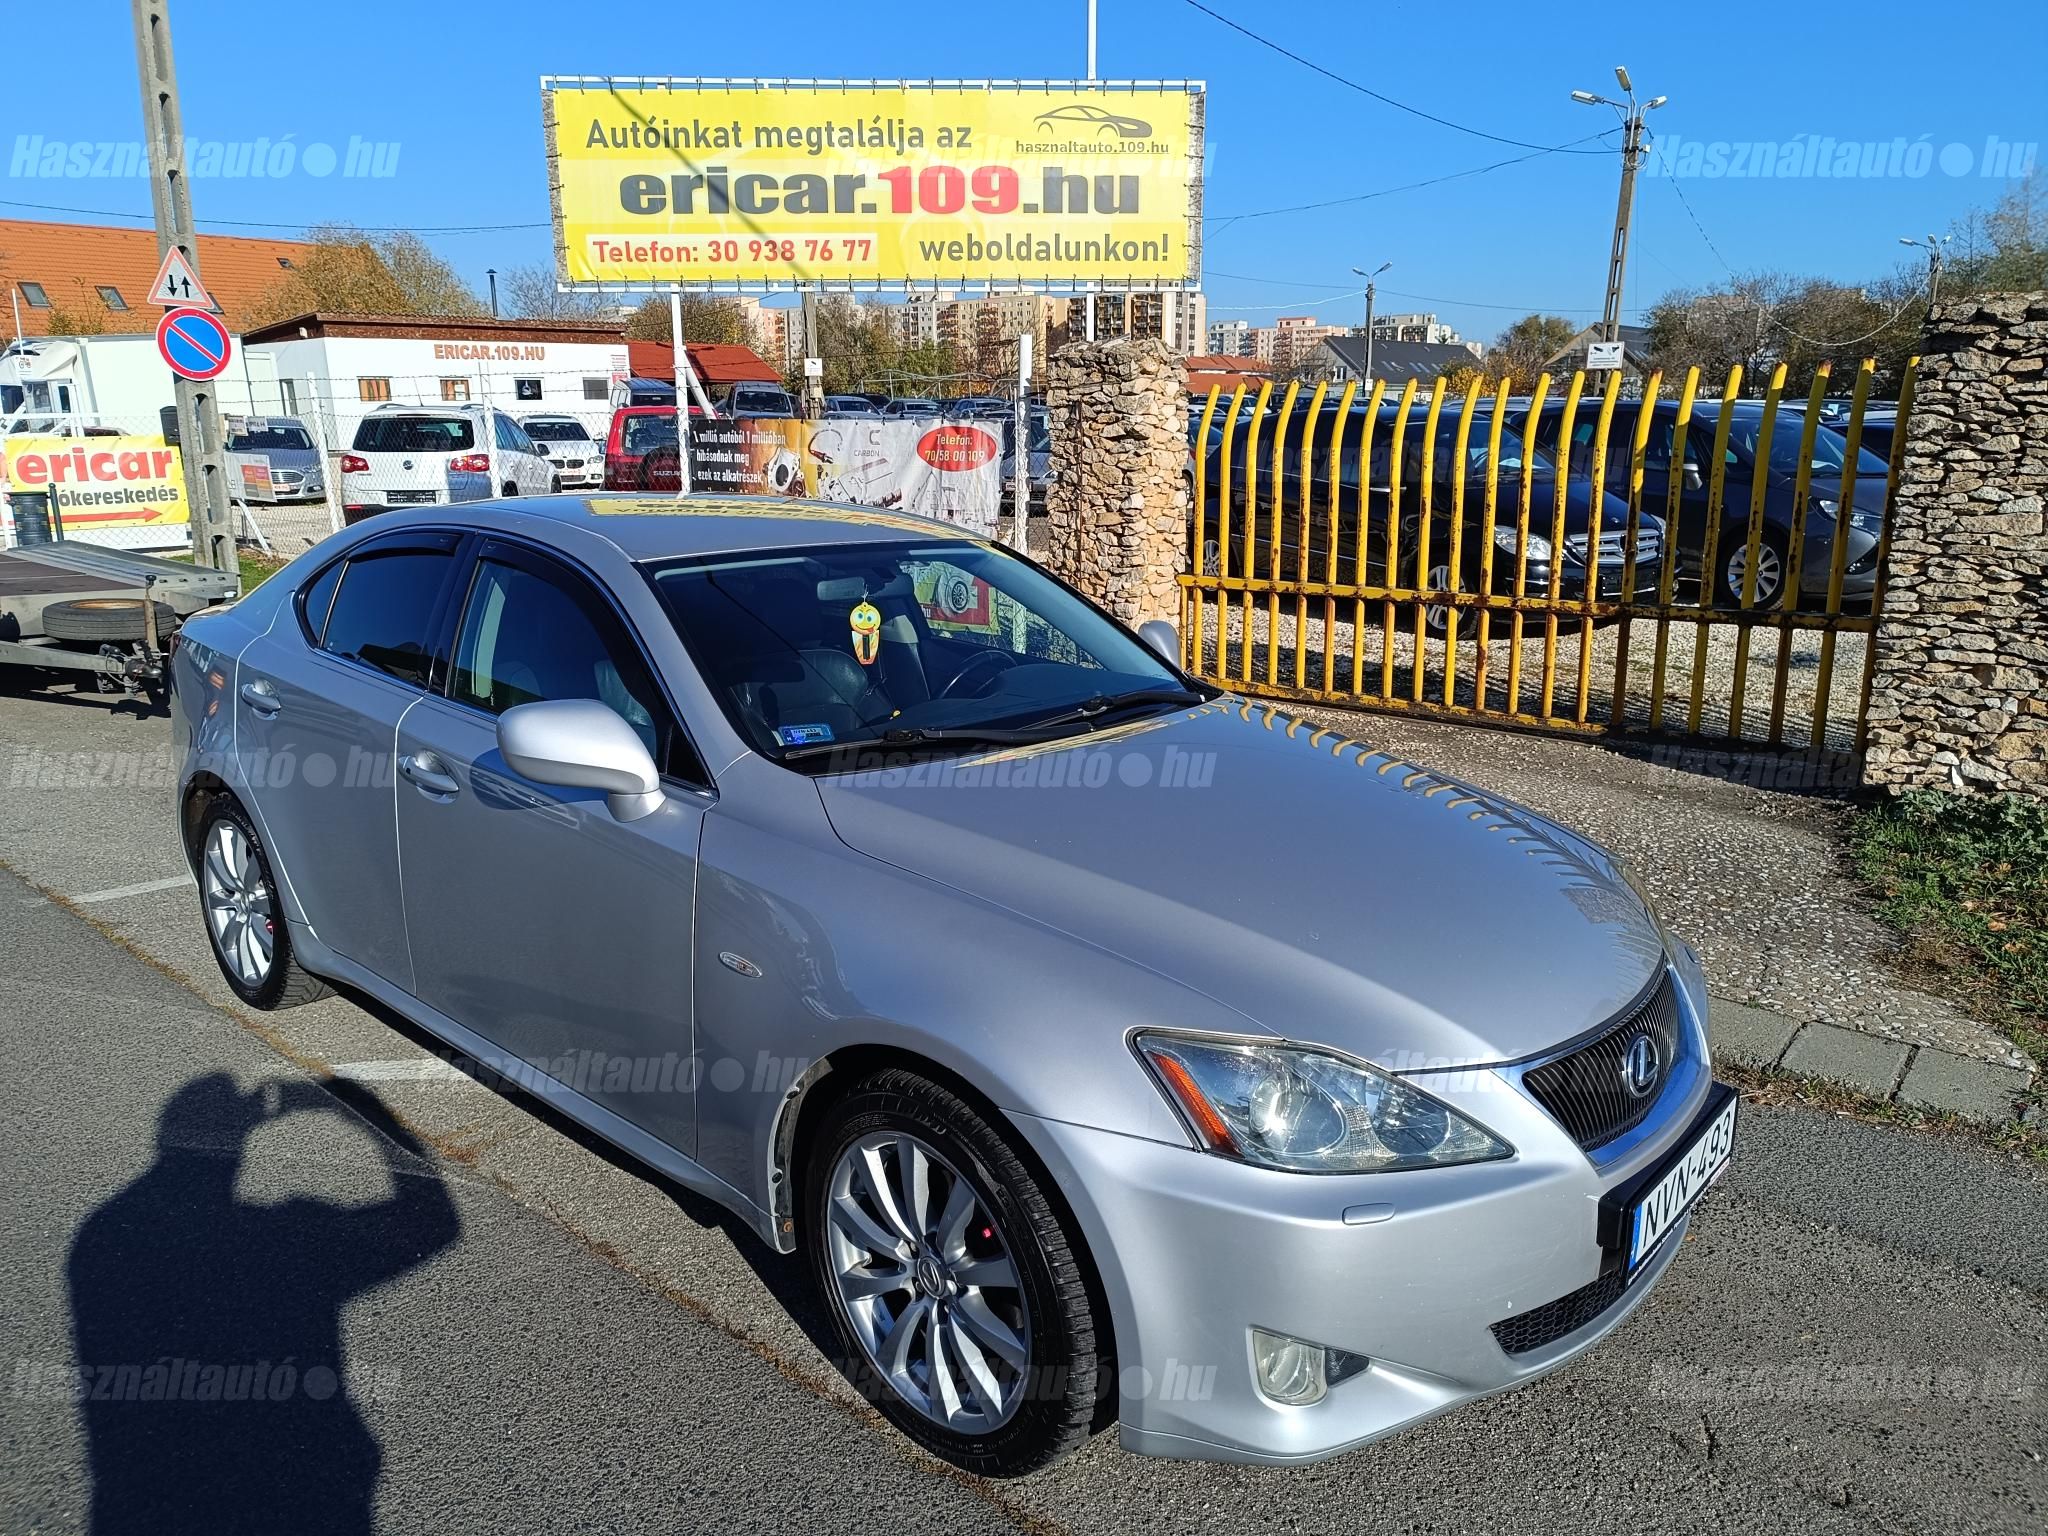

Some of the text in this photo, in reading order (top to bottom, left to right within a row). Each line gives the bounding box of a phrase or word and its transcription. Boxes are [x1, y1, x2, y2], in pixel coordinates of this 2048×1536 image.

[586, 115, 972, 156] Autóinkat megtalálja az
[1015, 141, 1169, 153] hasznaltauto.109.hu
[620, 166, 1139, 214] ericar.109.hu
[592, 239, 871, 263] Telefon: 30 938 76 77
[920, 233, 1168, 262] weboldalunkon!
[434, 344, 545, 361] ERICAR.109.HU
[700, 430, 718, 443] millió
[719, 430, 745, 444] autóból
[752, 431, 786, 445] millióban
[936, 433, 973, 446] Telefon:
[696, 448, 750, 466] hibásodnak meg
[967, 450, 986, 462] 109
[16, 447, 173, 484] ericar
[697, 468, 710, 481] ezek
[713, 471, 721, 481] az
[1643, 1110, 1731, 1249] NVN-493
